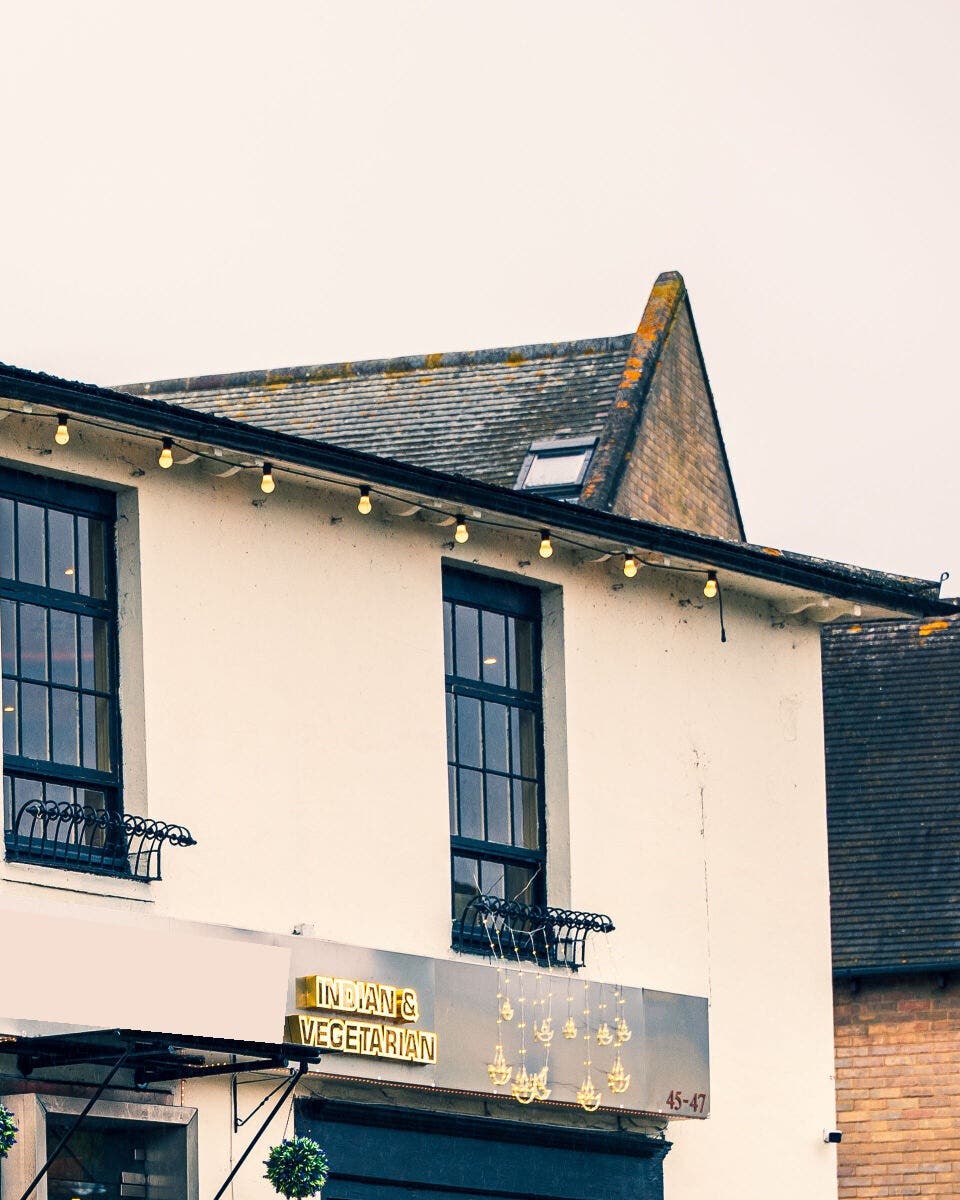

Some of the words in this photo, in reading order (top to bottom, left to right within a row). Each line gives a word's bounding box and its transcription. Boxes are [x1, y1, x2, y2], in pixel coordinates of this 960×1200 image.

[315, 975, 397, 1018] INDIAN
[400, 987, 420, 1023] &
[298, 1014, 437, 1065] VEGETARIAN
[665, 1090, 706, 1113] 45-47
